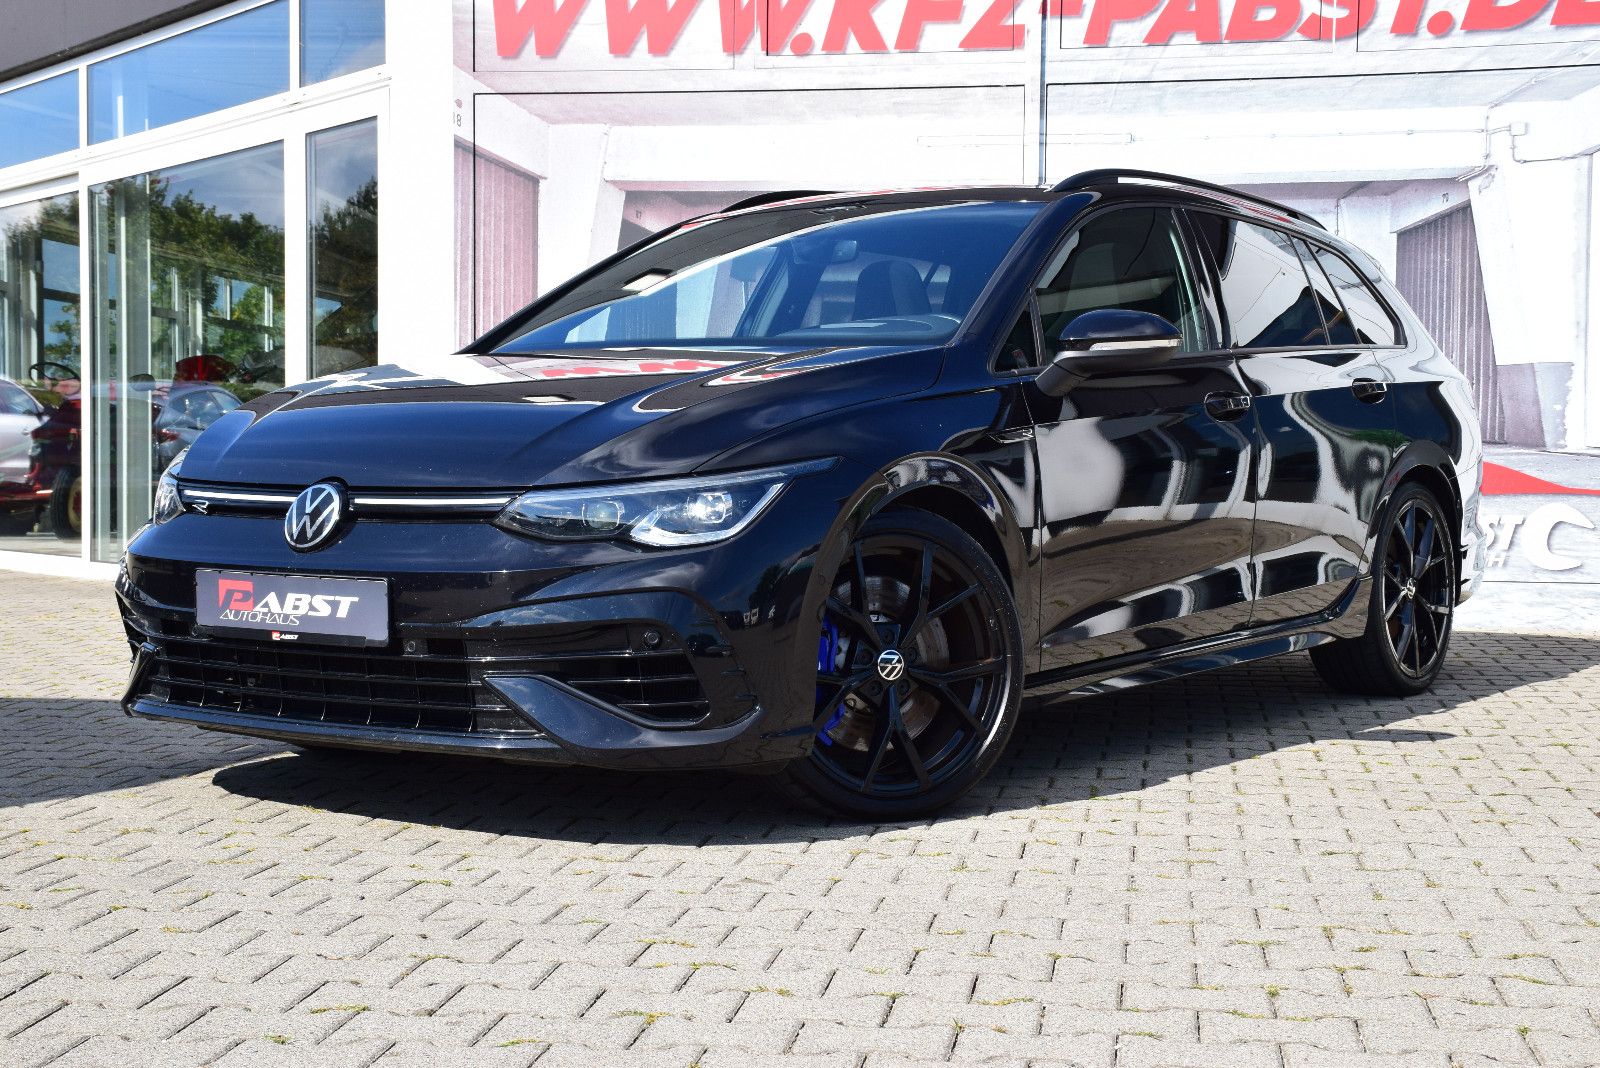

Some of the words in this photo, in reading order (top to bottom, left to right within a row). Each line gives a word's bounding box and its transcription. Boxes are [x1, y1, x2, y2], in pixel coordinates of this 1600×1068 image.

[490, 0, 1600, 58] WWW.KFZ-PABS.
[218, 584, 360, 619] PABST
[219, 609, 301, 626] AUTOHAUS
